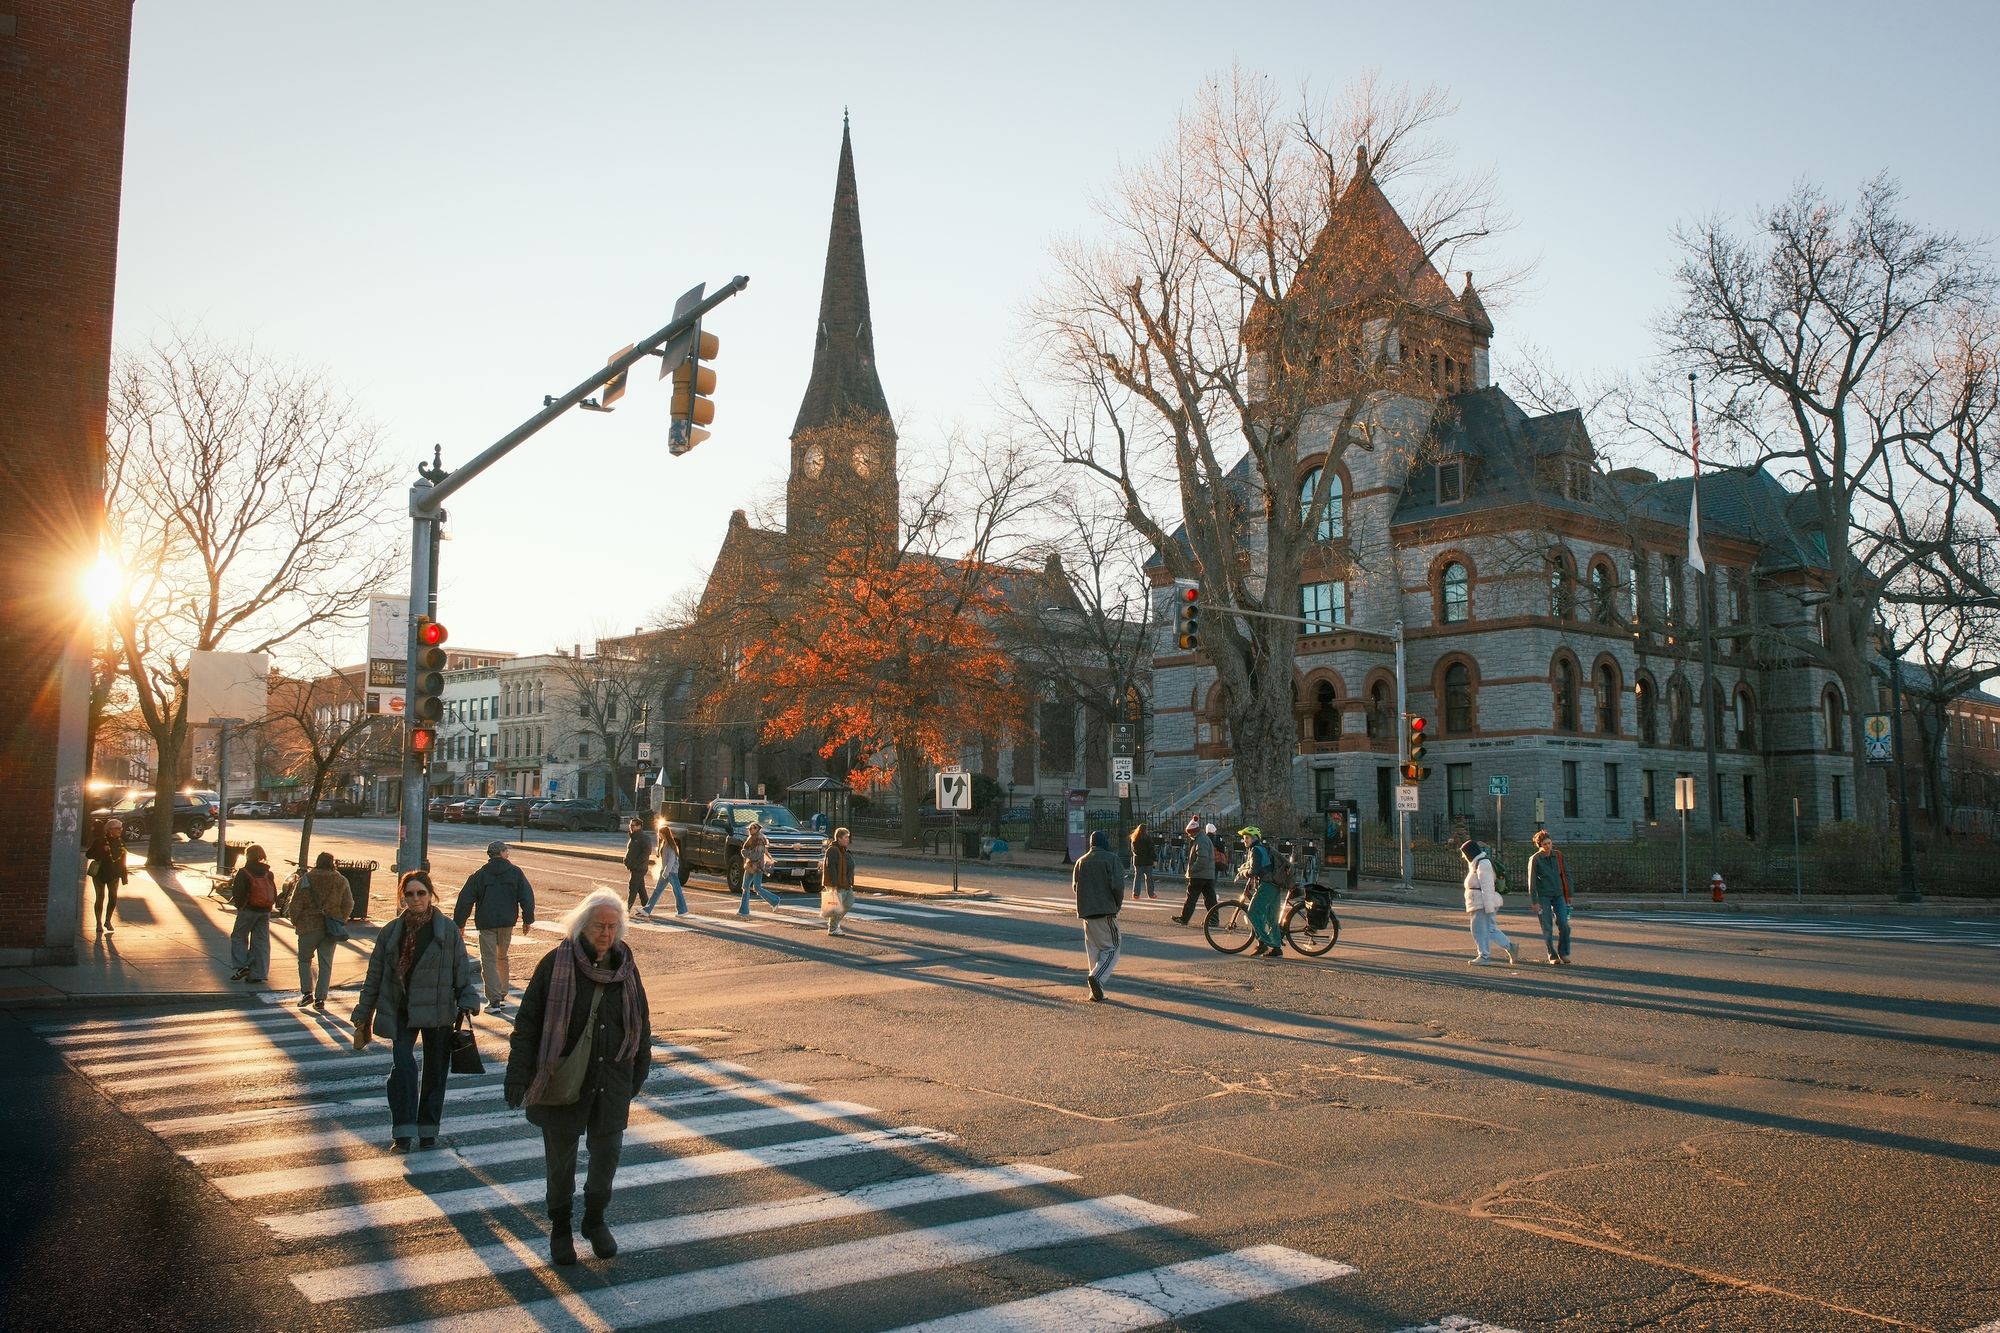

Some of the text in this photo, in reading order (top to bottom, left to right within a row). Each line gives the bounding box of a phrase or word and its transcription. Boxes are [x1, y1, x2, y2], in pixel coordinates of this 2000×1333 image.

[371, 662, 395, 671] HOT
[640, 750, 648, 758] 10
[1115, 770, 1131, 780] 25
